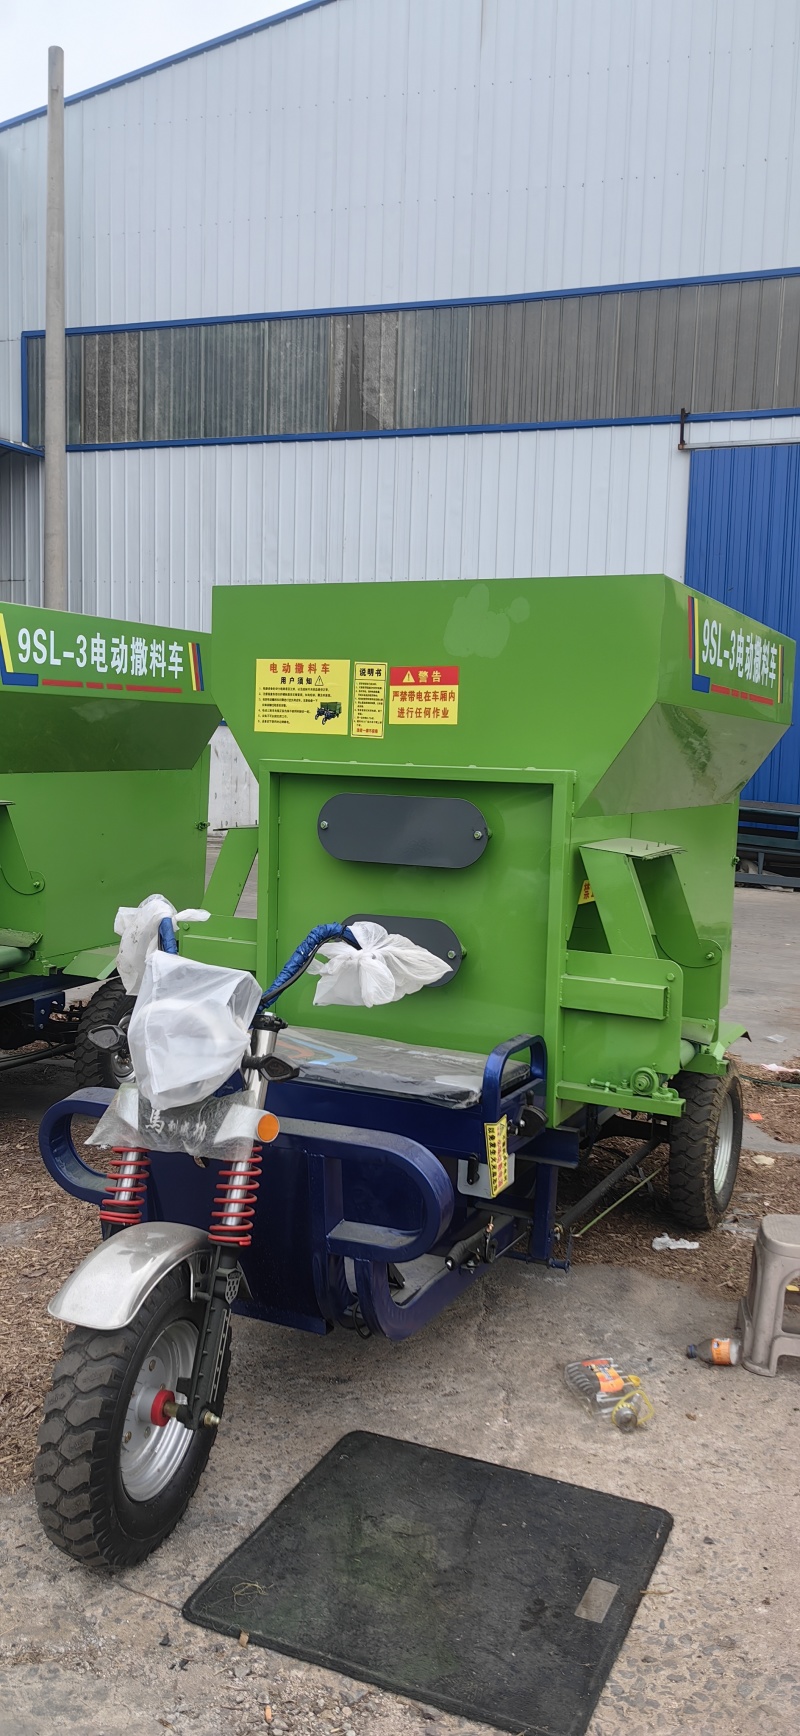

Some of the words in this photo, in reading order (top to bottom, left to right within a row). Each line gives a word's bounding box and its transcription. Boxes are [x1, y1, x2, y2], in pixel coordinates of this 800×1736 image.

[18, 628, 184, 680] 9SL-3电动撒料车
[269, 662, 330, 674] 电动撒料车
[359, 667, 382, 677] 说明书
[280, 676, 313, 685] 用户须知
[418, 670, 442, 683] 警告
[392, 690, 456, 702] 严禁带电在车厢内
[397, 707, 450, 719] 进行任何作业
